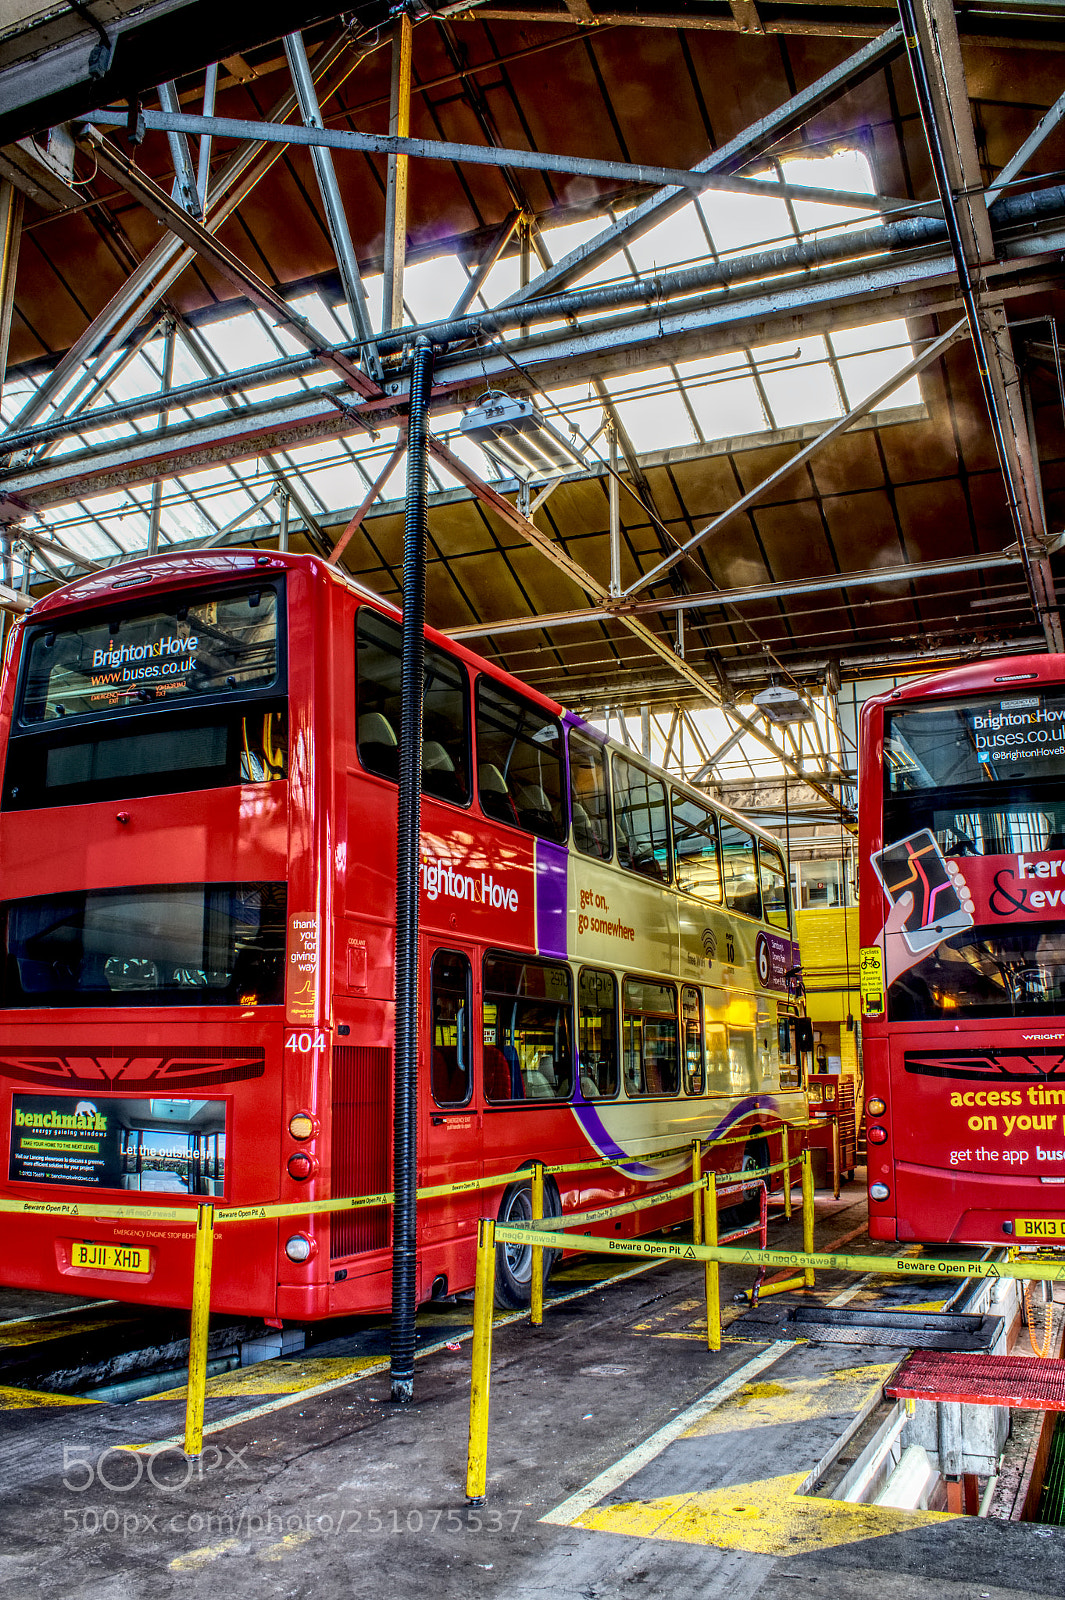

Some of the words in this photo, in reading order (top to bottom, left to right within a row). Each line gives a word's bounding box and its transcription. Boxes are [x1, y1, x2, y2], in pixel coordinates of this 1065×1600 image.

[92, 636, 199, 668] Brighton&Hove
[91, 656, 197, 686] www.buses.co.uk
[973, 709, 1065, 730] Brighton&Hov
[1018, 855, 1065, 879] her
[419, 856, 518, 912] righton&Hove
[989, 869, 1039, 915] &
[580, 888, 593, 910] get
[293, 919, 317, 929] thank
[578, 913, 589, 935] go
[590, 917, 635, 941] somewhere
[300, 931, 317, 941] you
[304, 940, 317, 950] for
[290, 951, 317, 964] giving
[727, 943, 735, 963] 10
[759, 940, 768, 980] 6
[298, 964, 317, 974] way
[285, 1033, 326, 1052] 404
[950, 1089, 1022, 1107] access
[15, 1108, 107, 1131] benchmark
[967, 1115, 998, 1131] on
[1002, 1115, 1057, 1136] your
[53, 1129, 78, 1137] gaining
[80, 1130, 107, 1138] windows
[120, 1143, 138, 1155] Let
[139, 1144, 157, 1157] the
[158, 1146, 200, 1159] outside
[203, 1147, 213, 1160] in
[950, 1148, 972, 1165] get
[974, 1147, 999, 1161] the
[1002, 1149, 1029, 1165] app
[24, 1204, 44, 1212] Beware
[45, 1204, 61, 1213] Open
[351, 1198, 366, 1206] Beware
[366, 1196, 376, 1205] Open
[218, 1211, 237, 1219] Beware
[238, 1209, 251, 1218] Open
[251, 1208, 259, 1216] Pit
[113, 1228, 145, 1238] EMERGENCY
[146, 1230, 167, 1239] ENGINE
[167, 1231, 181, 1239] STOP
[181, 1232, 197, 1240] BEHI
[1024, 1221, 1057, 1235] BK13
[609, 1240, 642, 1252] Beware
[644, 1243, 667, 1255] Open
[668, 1246, 681, 1256] Pit
[79, 1246, 106, 1265] BJ11
[114, 1249, 141, 1269] XHD
[897, 1260, 936, 1271] Beware
[937, 1262, 966, 1274] Open
[968, 1263, 982, 1274] Pit
